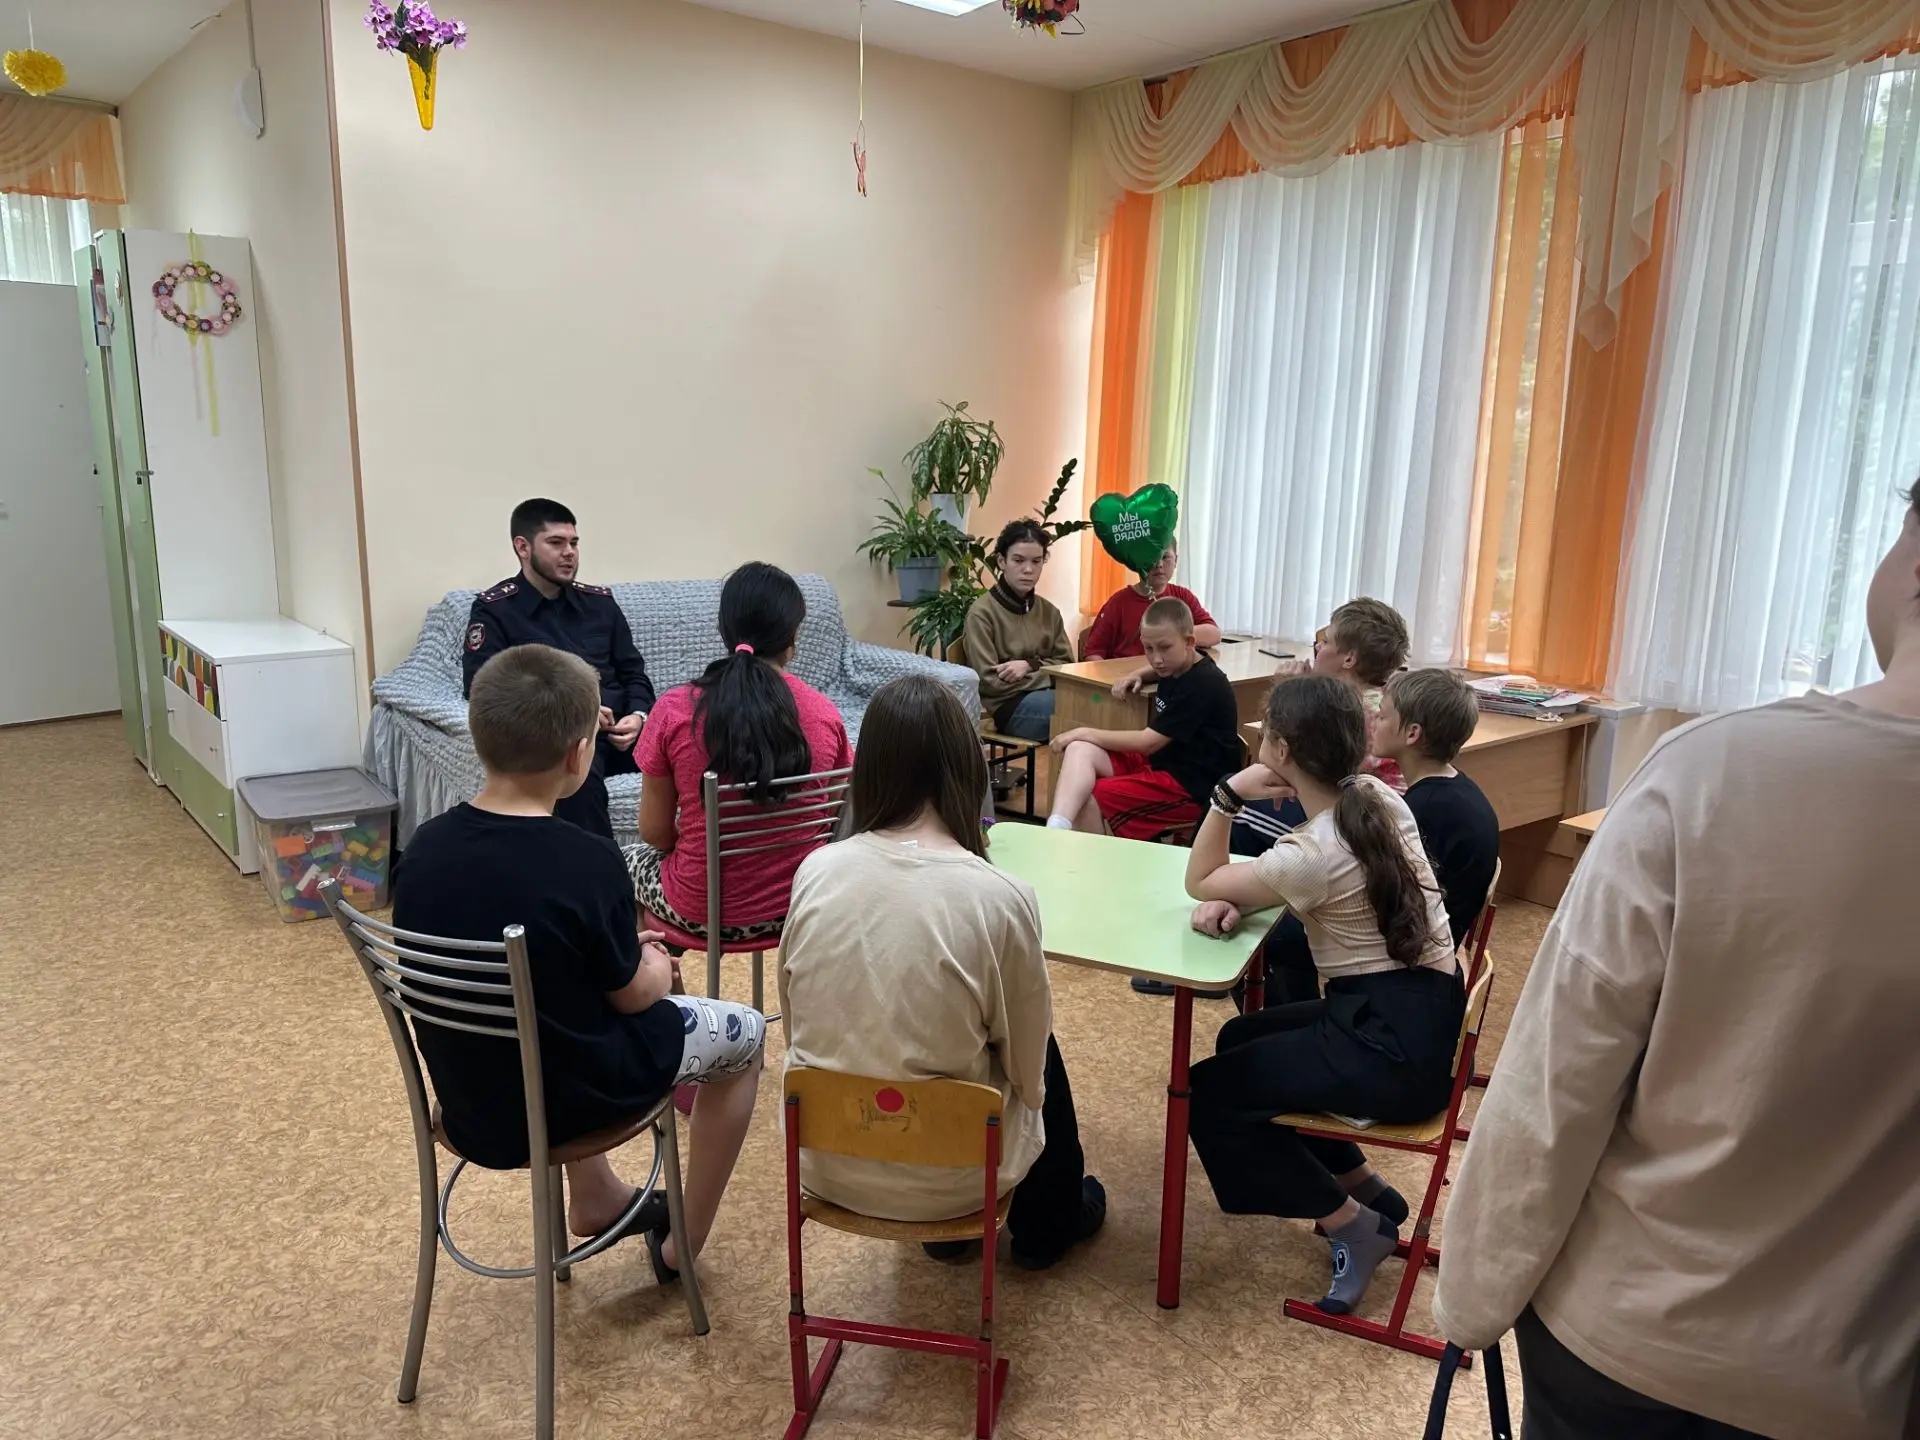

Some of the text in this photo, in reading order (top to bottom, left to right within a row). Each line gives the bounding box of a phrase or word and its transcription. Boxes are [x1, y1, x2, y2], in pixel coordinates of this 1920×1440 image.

[1119, 511, 1138, 523] Мы
[1111, 519, 1150, 533] всегда
[1114, 528, 1151, 544] рядом
